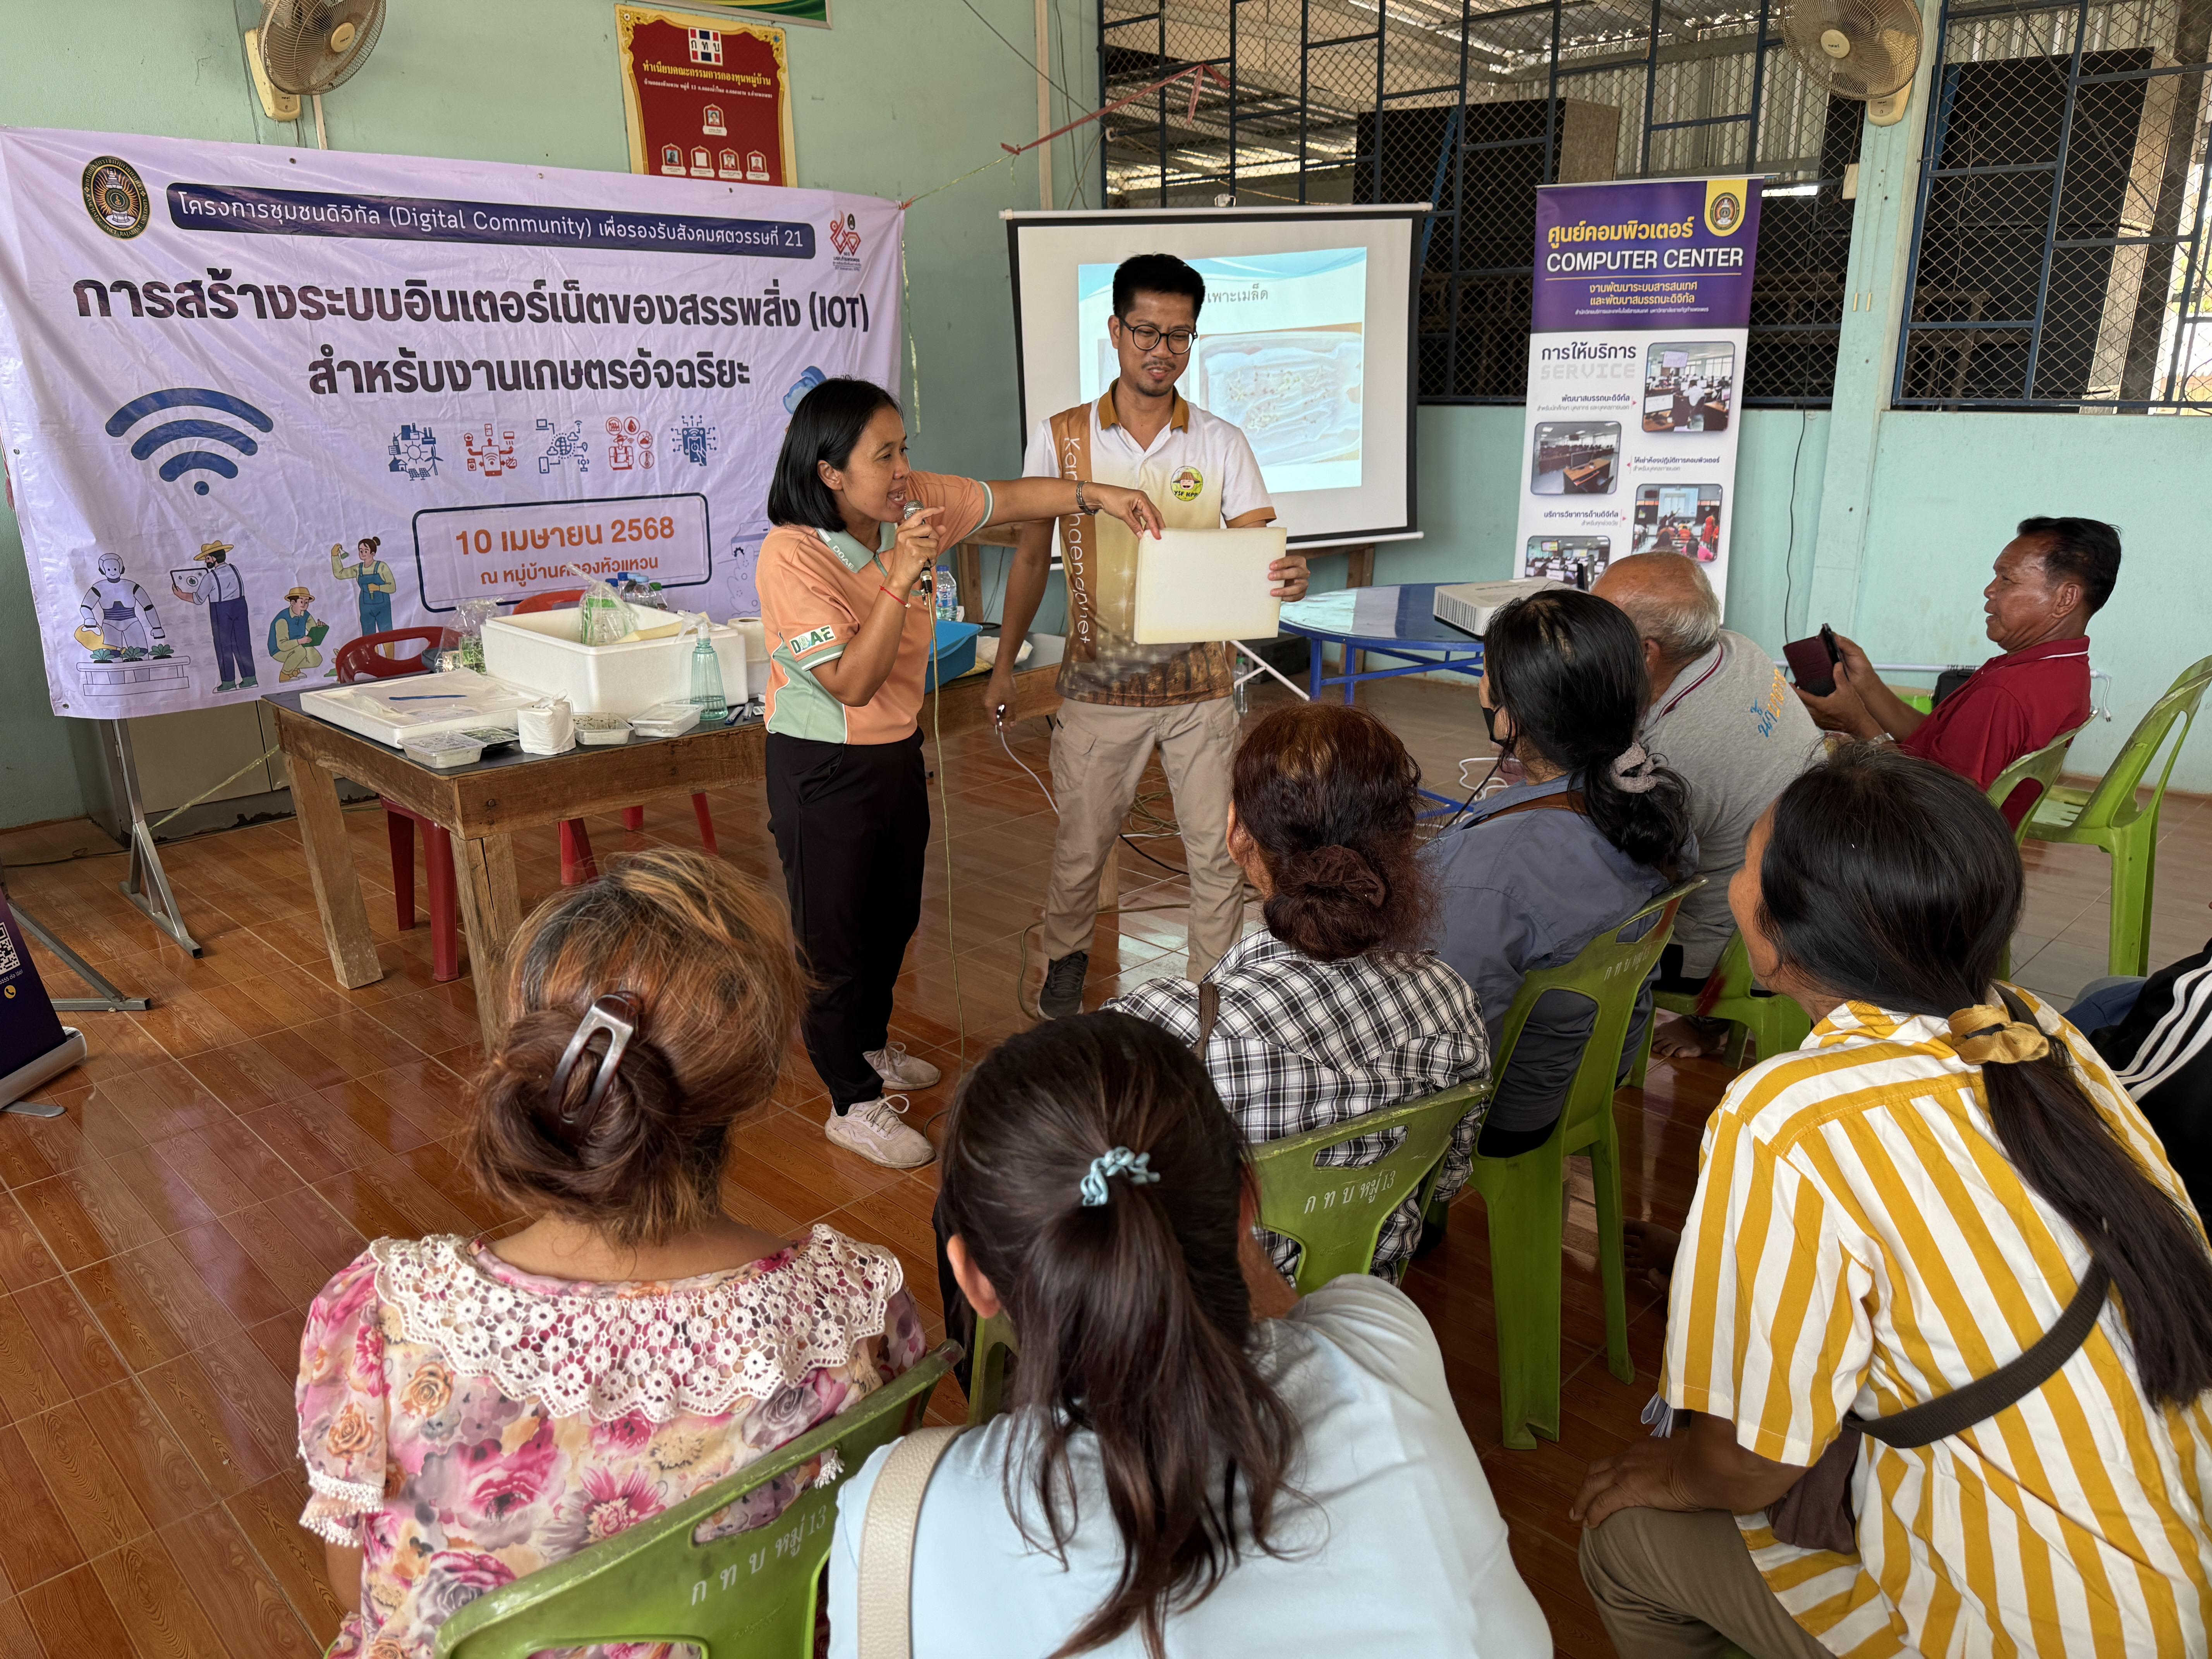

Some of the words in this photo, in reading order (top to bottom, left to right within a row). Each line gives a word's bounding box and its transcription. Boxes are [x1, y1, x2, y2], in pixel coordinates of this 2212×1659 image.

[691, 40, 697, 49] ก
[702, 41, 708, 51] ท
[713, 42, 720, 52] บ
[178, 191, 380, 225] โครงการชุมชนดิจิทัล
[389, 206, 466, 231] (Digital
[474, 211, 592, 239] Community)
[599, 216, 779, 246] เพื่อรองรับสังคมศตวรรษที่
[785, 230, 803, 248] 21
[1548, 216, 1695, 249] ศูนย์คอมพิวเตอร์
[1547, 249, 1657, 272] COMPUTER
[1664, 247, 1743, 268] CENTER
[73, 267, 801, 327] การสร้างระบบอินเตอร์เน็ตของสรรพสิ่ง
[809, 291, 869, 331] (IOT)
[1207, 283, 1268, 303] เพาะเมล็ด
[1589, 281, 1697, 294] งานพัฒนาระบบสารสนเทศ
[1590, 293, 1695, 306] และพัฒนาสมรรถนะดิจิทัล
[1542, 342, 1637, 361] การให้บริการ
[309, 343, 750, 395] สำหรับงานเกษตรอัจฉริยะ
[1541, 363, 1635, 380] SERVICE
[1561, 393, 1630, 402] พัฒนาสมรรถนะดิจิทัล
[456, 529, 492, 555] 10
[501, 524, 603, 552] เมษายน
[611, 516, 675, 543] 2568
[832, 545, 854, 570] DOAE
[480, 570, 498, 585] ณ
[1304, 1195, 1316, 1214] ก
[1324, 1190, 1336, 1209] ท
[1342, 1185, 1355, 1204] บ
[692, 1580, 707, 1606] ก
[720, 1564, 737, 1590] ท
[749, 1547, 766, 1575] บ
[808, 1505, 827, 1536] 13
